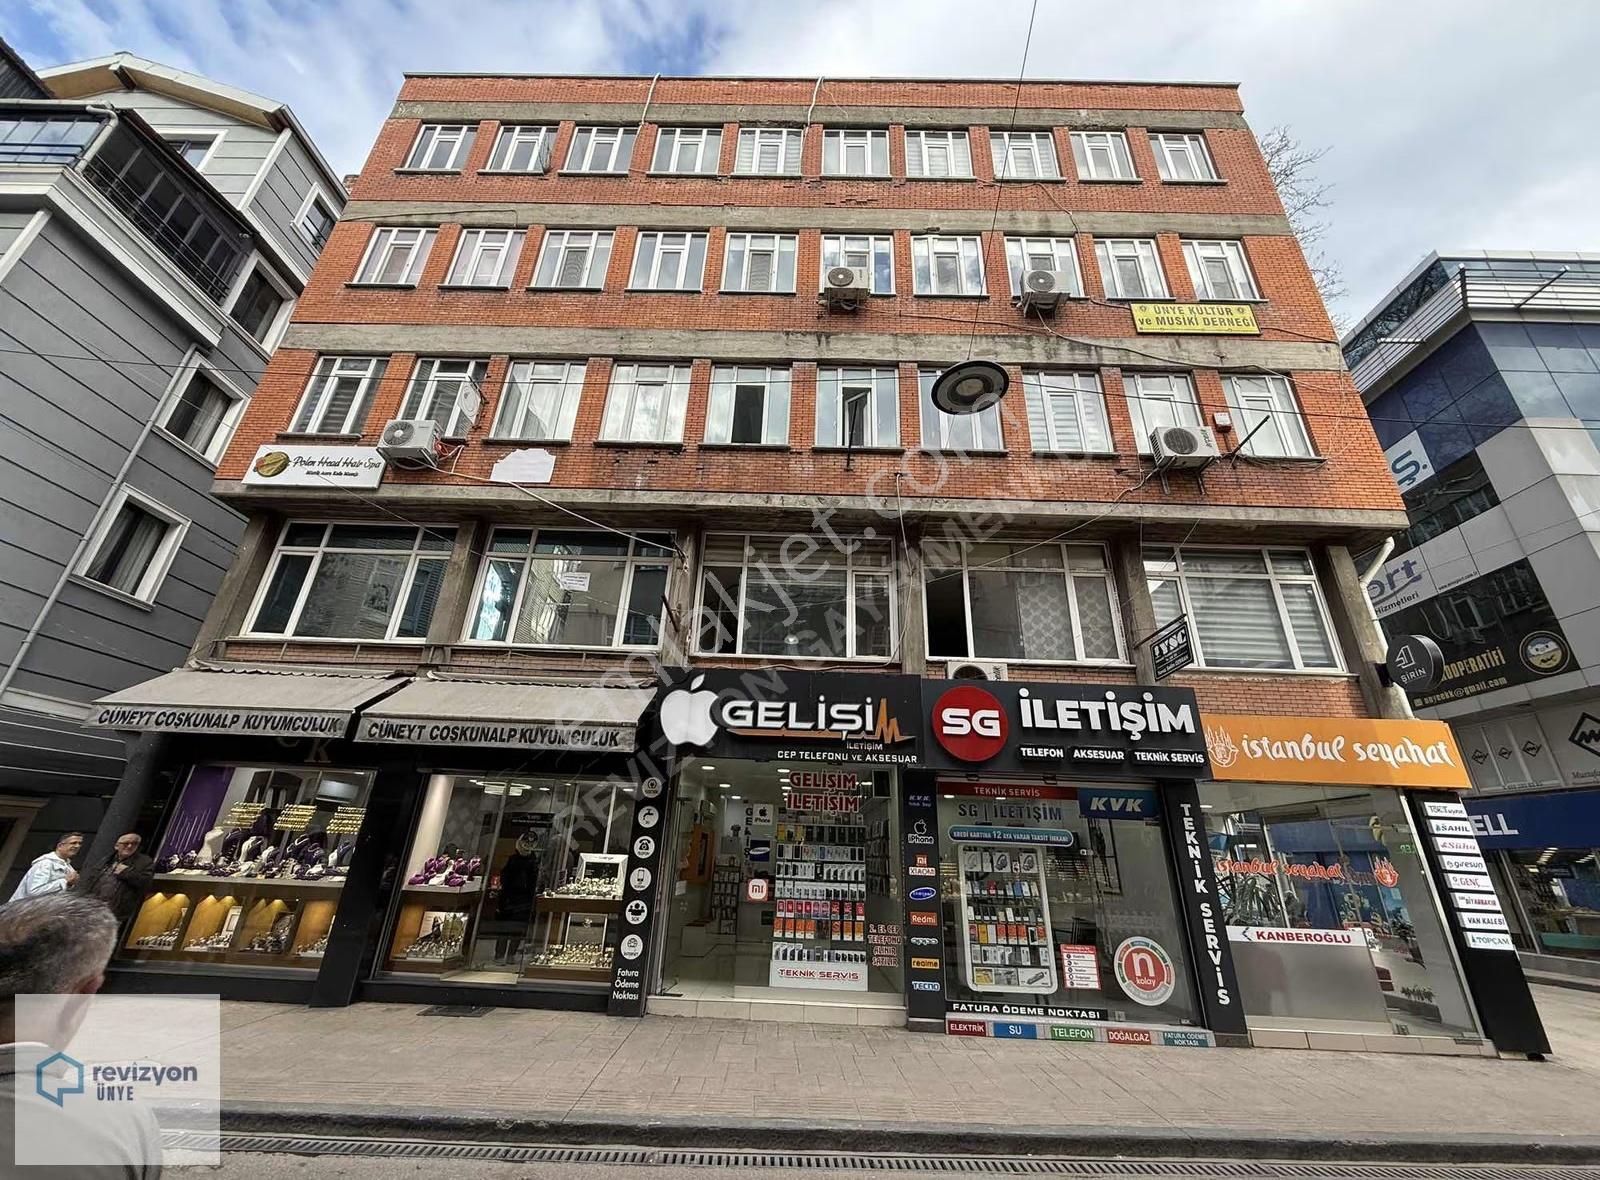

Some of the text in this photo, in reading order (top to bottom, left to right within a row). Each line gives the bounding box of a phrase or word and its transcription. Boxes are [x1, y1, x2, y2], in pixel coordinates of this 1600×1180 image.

[1153, 305, 1184, 315] ÜNYE
[1138, 315, 1256, 328] ve MUSİKİ DERNEĞİ
[364, 457, 382, 469] Spa
[1400, 667, 1427, 684] ŞİRİN
[98, 706, 155, 725] CÜNEYT
[242, 715, 341, 733] KUYUMCULUK
[722, 695, 903, 743] GELİŞİM
[1019, 687, 1196, 741] İLETİŞİM
[941, 707, 1001, 737] SG
[368, 719, 425, 738] CÜNEYT
[518, 727, 620, 747] KUYUMCULUK
[777, 751, 796, 760] CEP
[799, 751, 849, 761] TELEFONU
[865, 753, 918, 764] AKSESUAR
[1020, 748, 1064, 758] TELEFON
[1073, 750, 1125, 761] AKSESUAR
[1241, 733, 1456, 769] istanbul seyahat
[789, 770, 858, 793] GELİŞİM
[974, 787, 1040, 797] TEKNİK SERVİS
[786, 790, 860, 816] İLETİŞİM
[1090, 797, 1144, 812] KVK
[958, 801, 1062, 821] SG İLETİŞİM
[993, 831, 1002, 839] 12
[1216, 858, 1280, 877] istanbul
[912, 914, 936, 924] Redmi
[1256, 931, 1350, 944] KANBEROĞLU
[912, 960, 938, 968] realme
[1132, 952, 1156, 977] n
[618, 968, 639, 977] Fatura
[778, 968, 816, 978] TEKNİK
[614, 976, 639, 989] Ödeme
[1136, 977, 1156, 987] kolay
[612, 990, 638, 1000] Noktası
[952, 1003, 1100, 1019] FATURA ÖDEME NOKTASI
[950, 1022, 985, 1032] ELEKTRİK
[1008, 1025, 1022, 1035] SU
[1052, 1027, 1094, 1039] TELEFON
[1108, 1029, 1150, 1042] DOĞALGAZ
